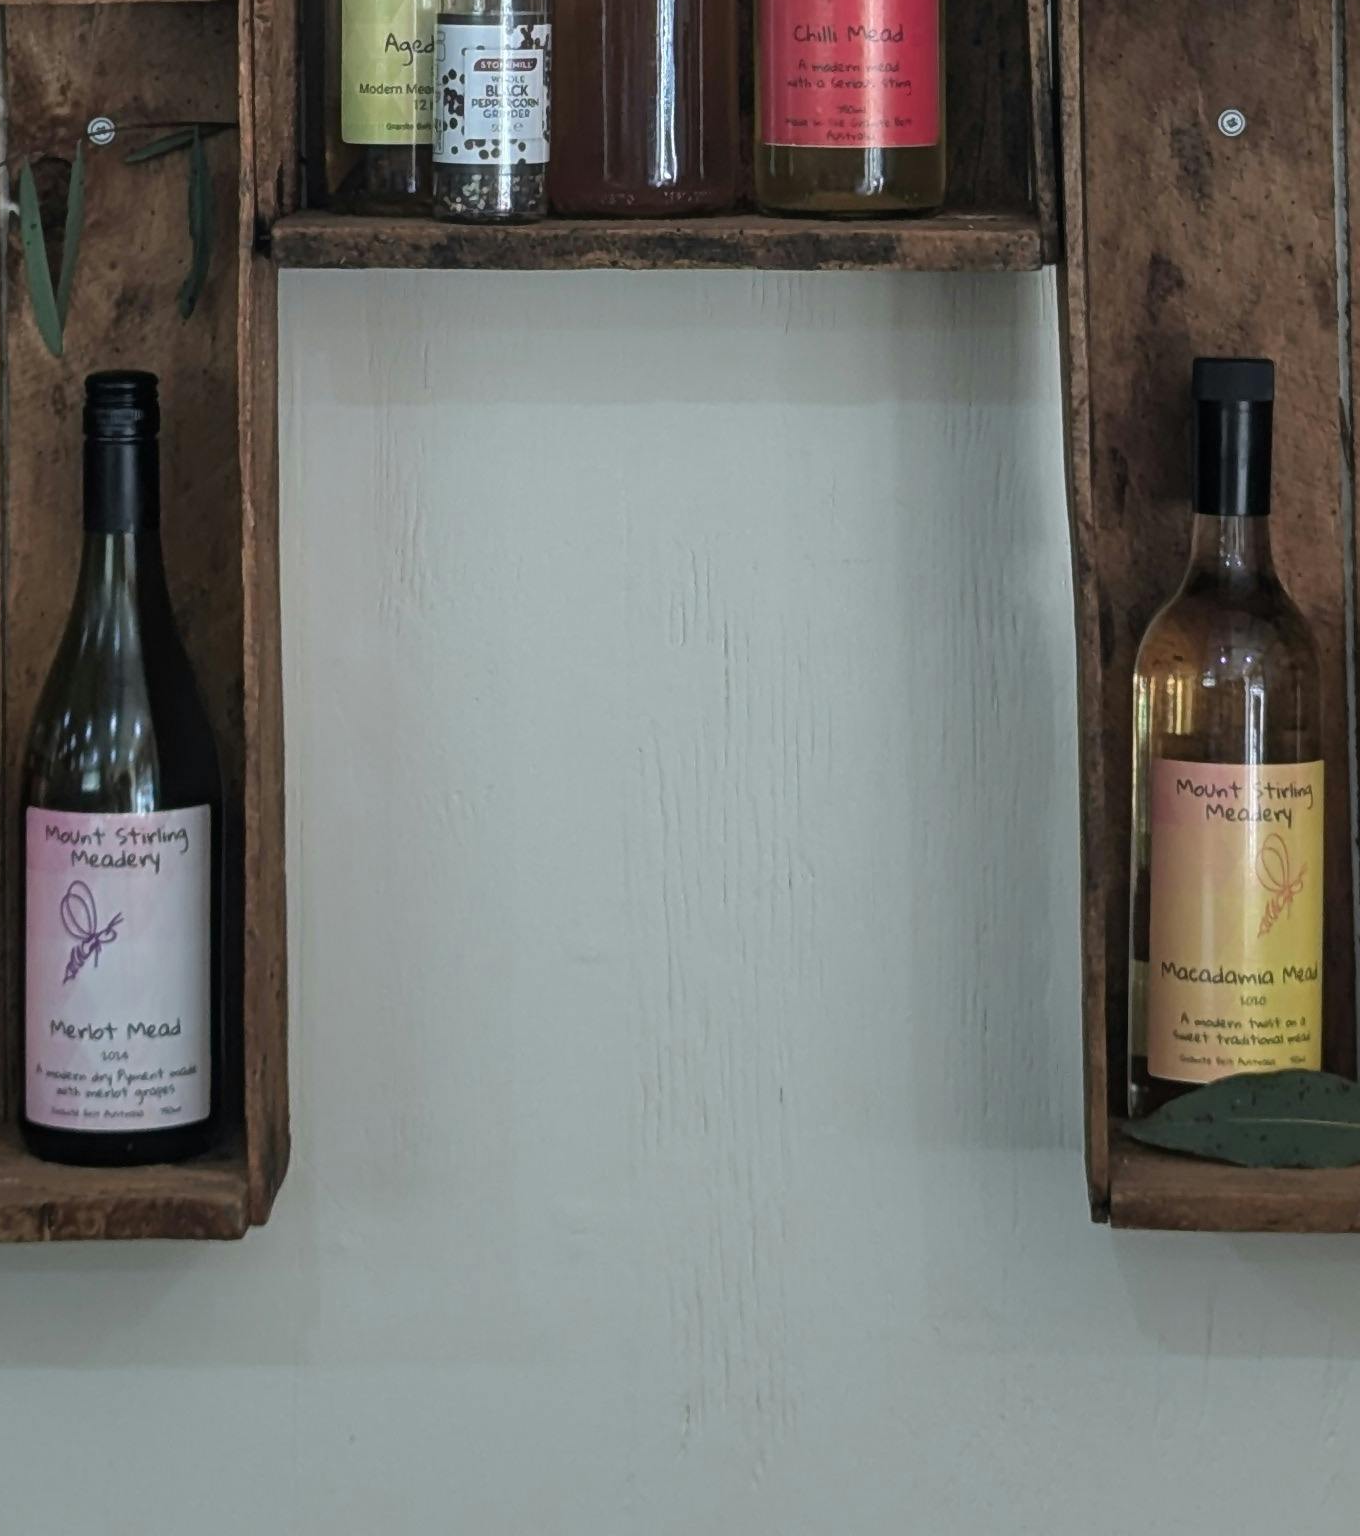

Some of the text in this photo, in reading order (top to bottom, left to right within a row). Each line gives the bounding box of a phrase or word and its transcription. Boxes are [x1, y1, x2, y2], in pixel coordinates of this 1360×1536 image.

[794, 25, 904, 43] Chilli Mead
[480, 60, 533, 68] STOMILL
[360, 84, 402, 94] Modern
[472, 99, 539, 108] PEPPCORN
[483, 109, 530, 118] GRDER
[1177, 778, 1314, 810] Mount Stirling
[1206, 804, 1292, 829] Meadery
[45, 824, 189, 855] Mount Stirling
[72, 850, 161, 874] Meadery
[1161, 961, 1318, 985] Macadamia Mead
[50, 1017, 182, 1041] Merlot Mead
